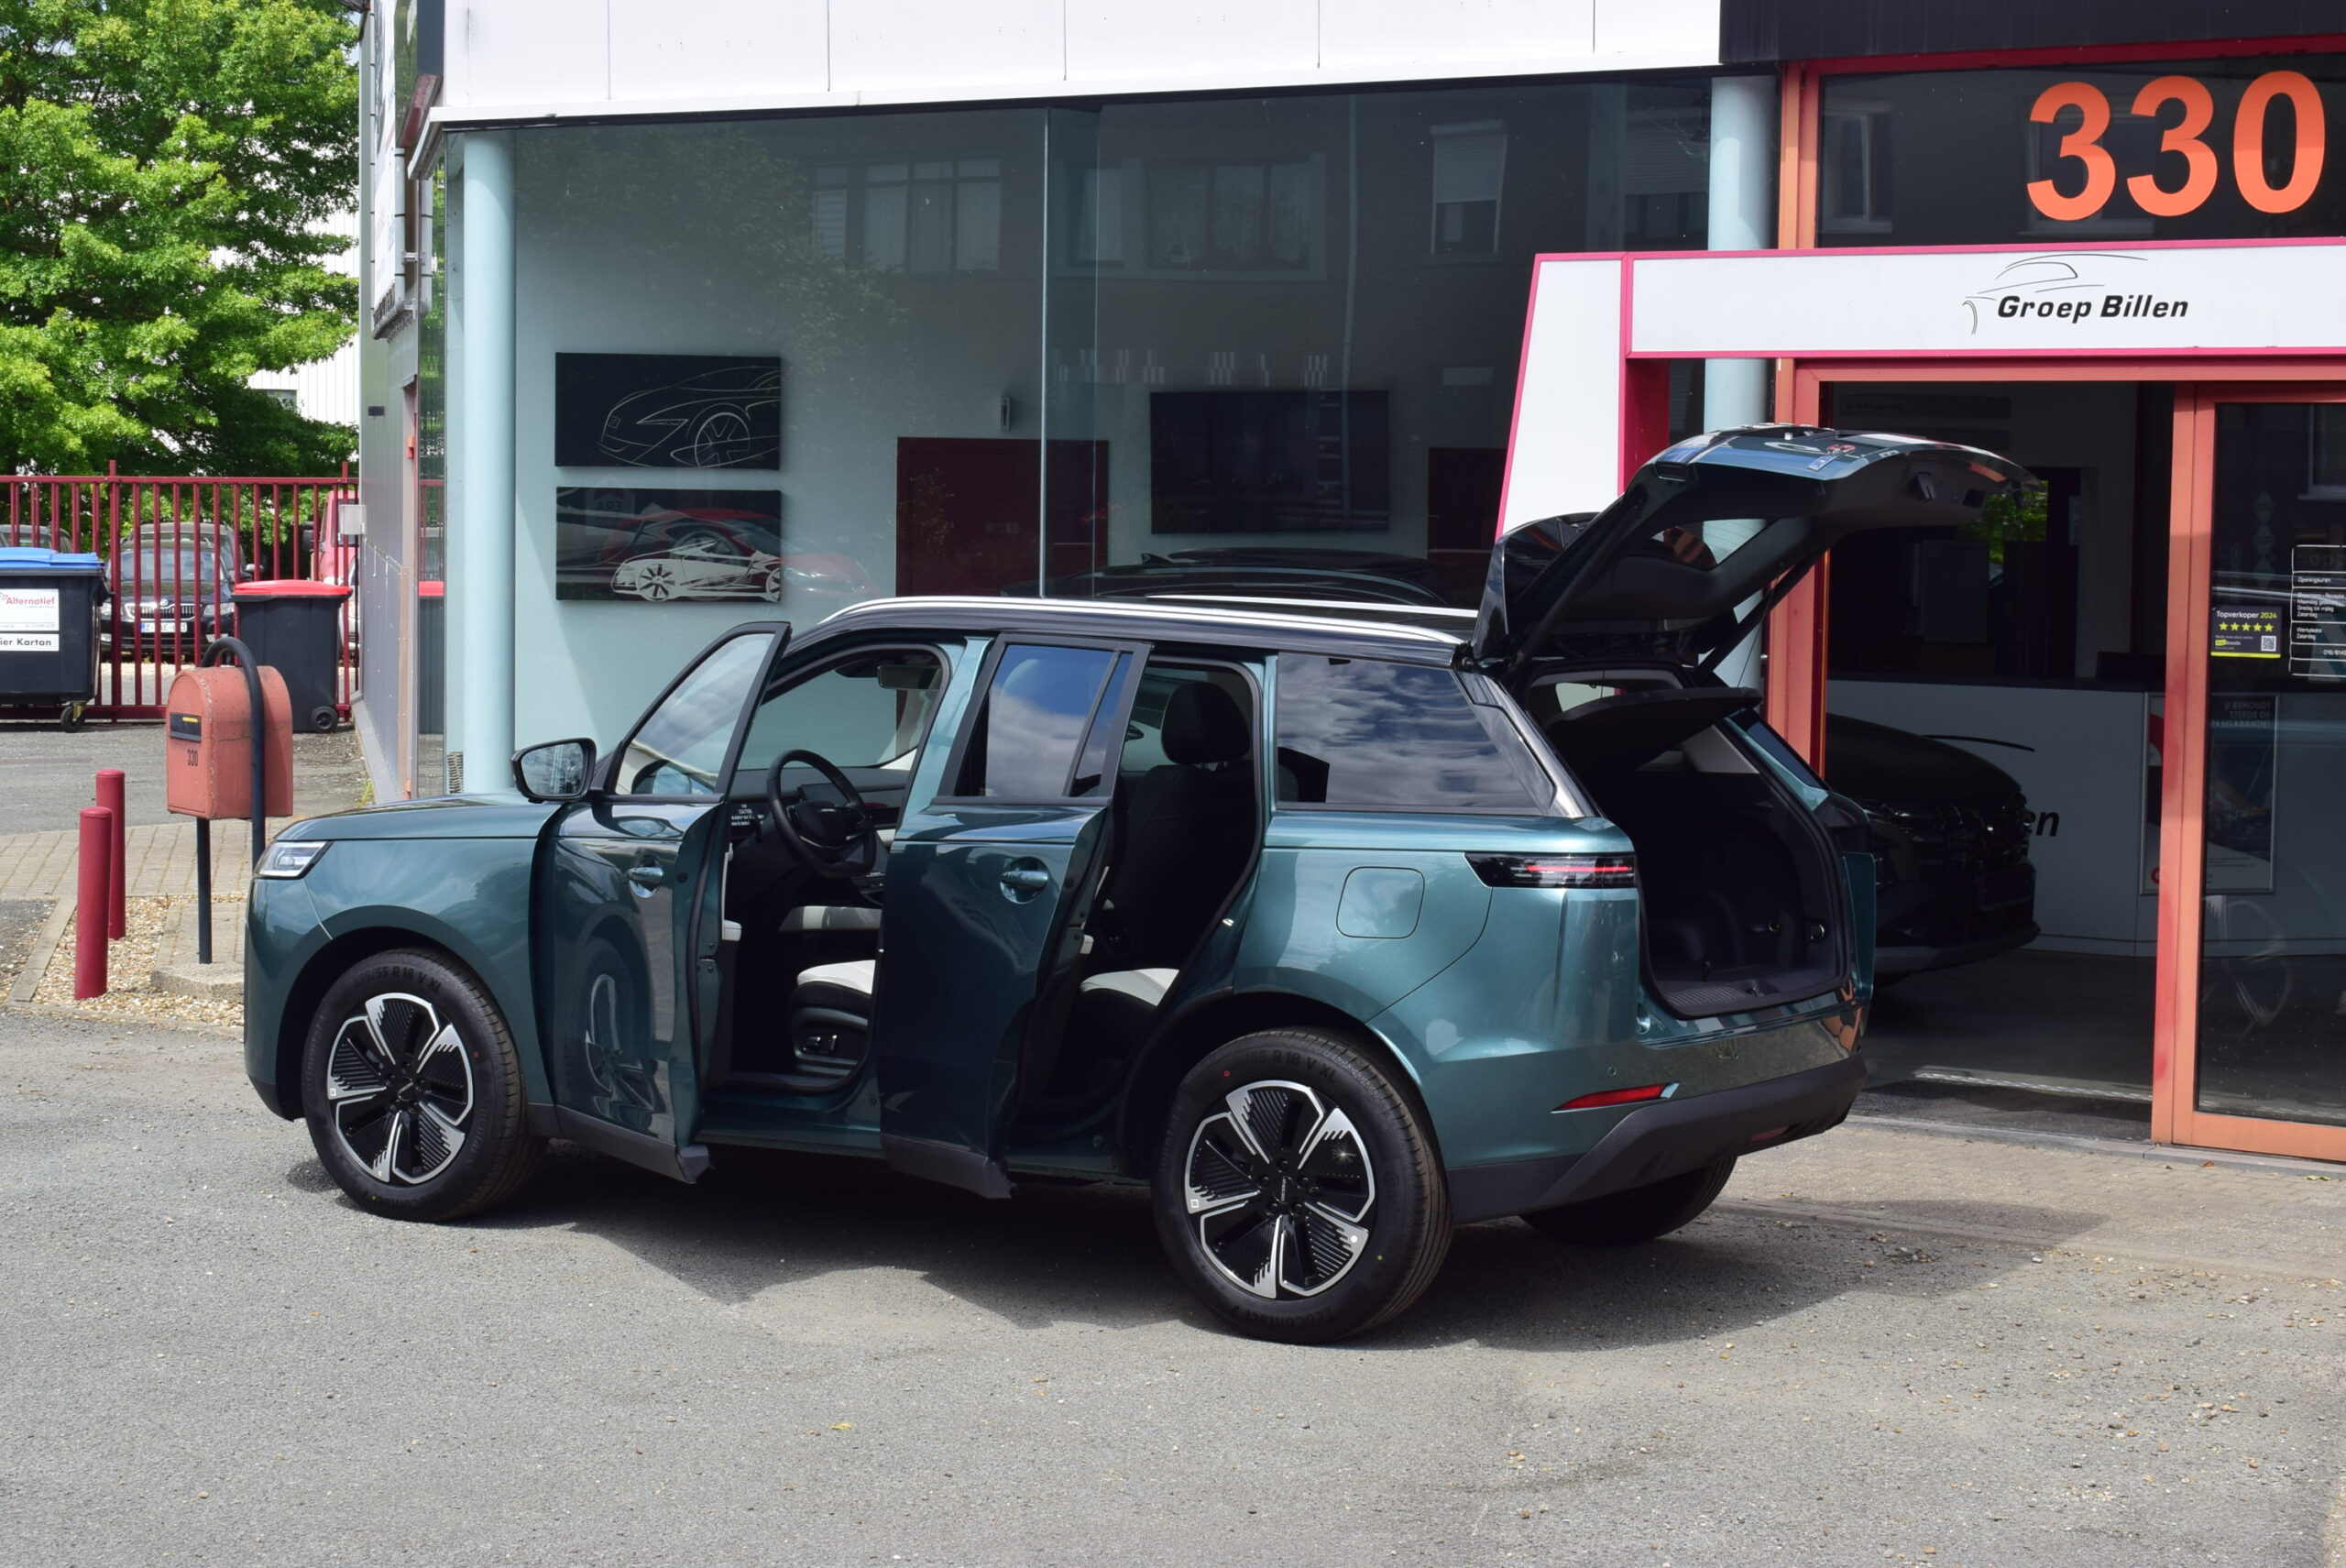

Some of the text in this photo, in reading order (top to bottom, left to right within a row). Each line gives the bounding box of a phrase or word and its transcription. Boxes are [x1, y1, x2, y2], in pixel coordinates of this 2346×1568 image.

[2027, 70, 2326, 221] 330
[1998, 294, 2188, 323] Groep Billen
[5, 597, 56, 605] Alternatief
[2216, 610, 2259, 620] Topverkoper
[16, 637, 52, 646] Karton
[187, 748, 199, 767] 330
